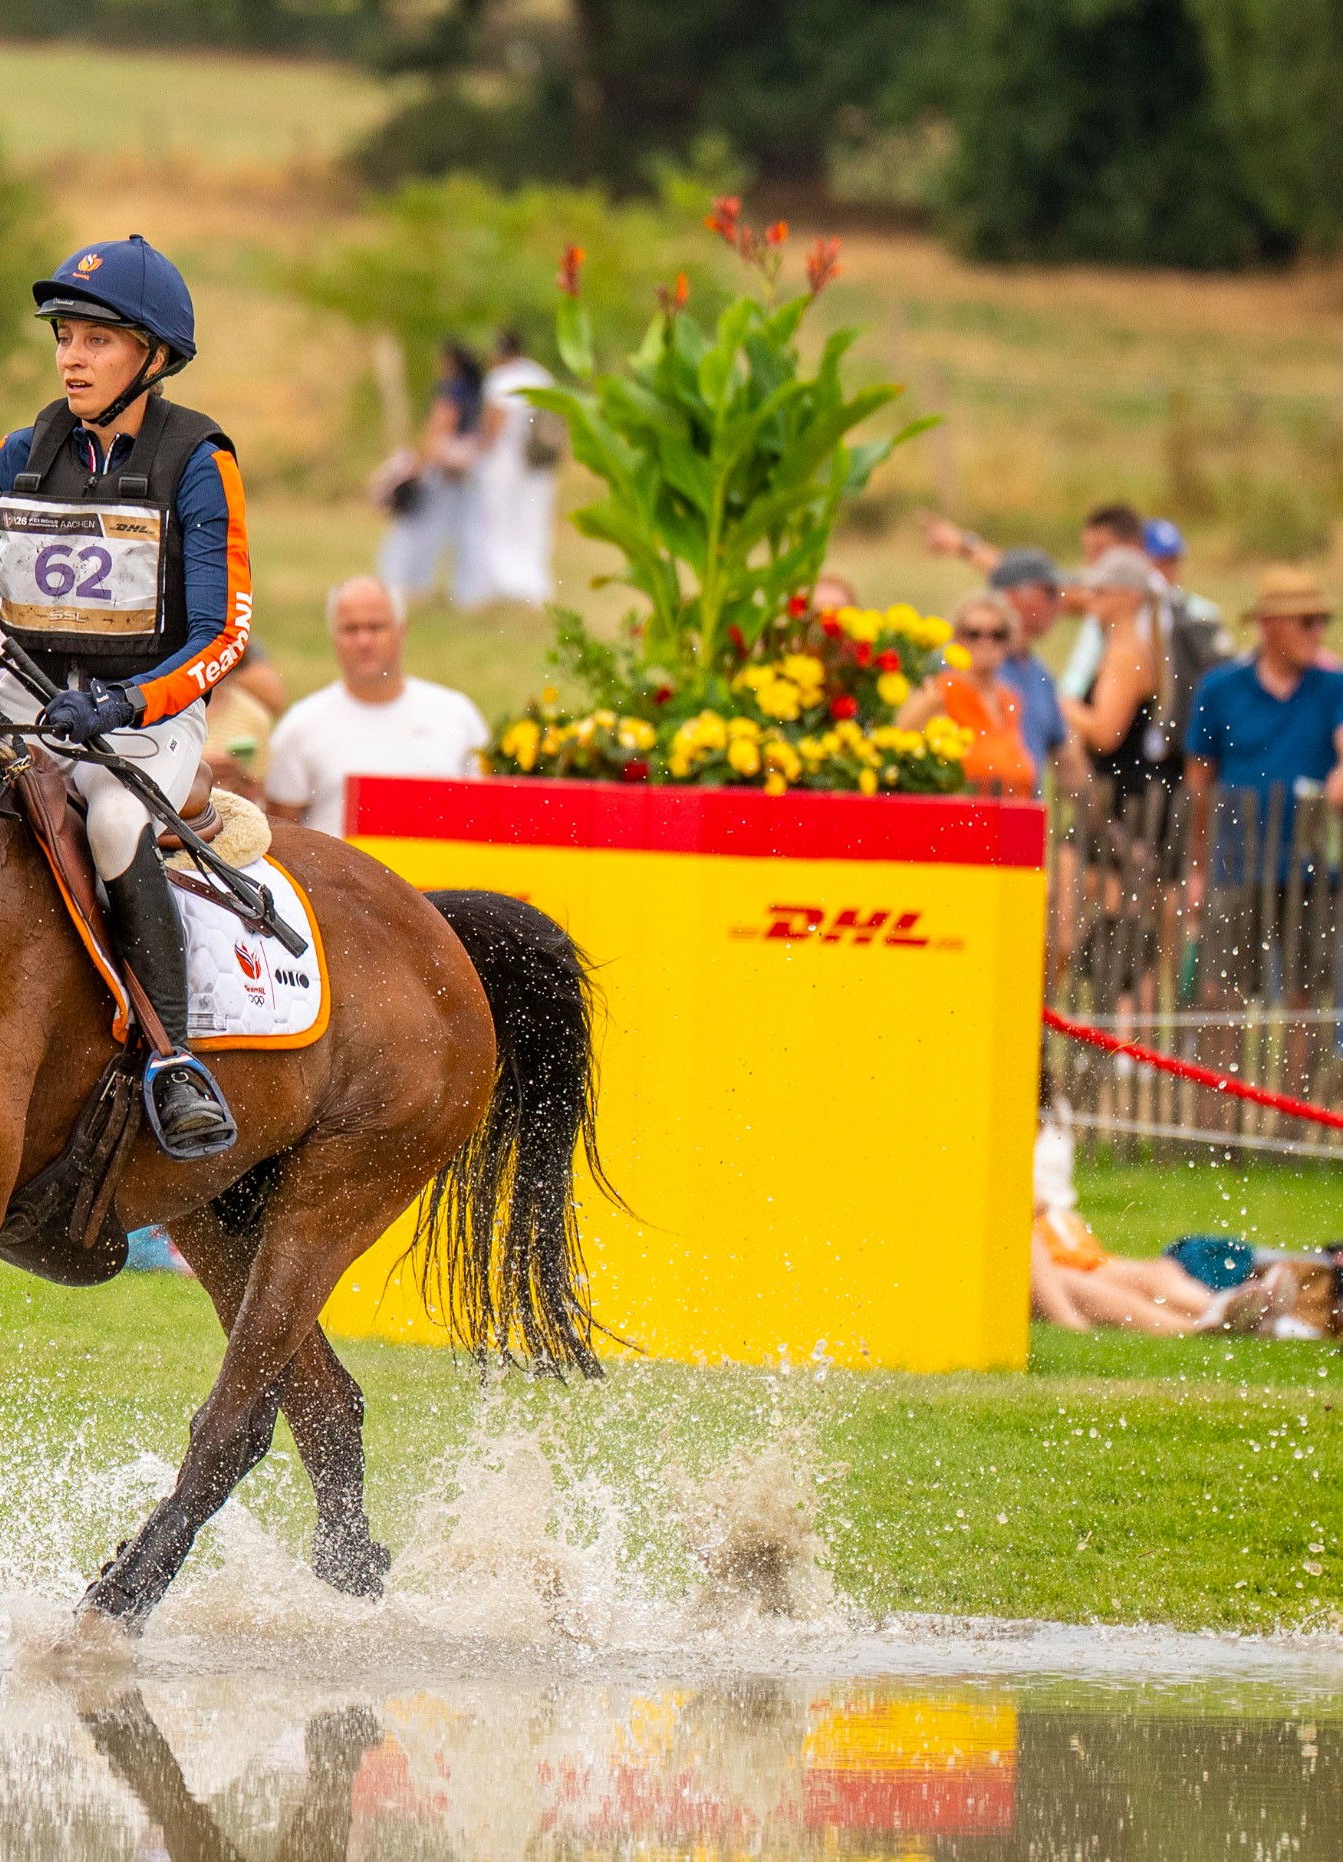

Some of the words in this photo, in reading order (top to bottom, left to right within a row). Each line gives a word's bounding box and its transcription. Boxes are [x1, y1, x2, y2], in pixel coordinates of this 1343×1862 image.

[60, 520, 95, 529] AACHEN
[115, 523, 148, 534] DHL
[35, 544, 112, 600] 62
[187, 592, 253, 689] TeamNL
[765, 904, 926, 945] DHL
